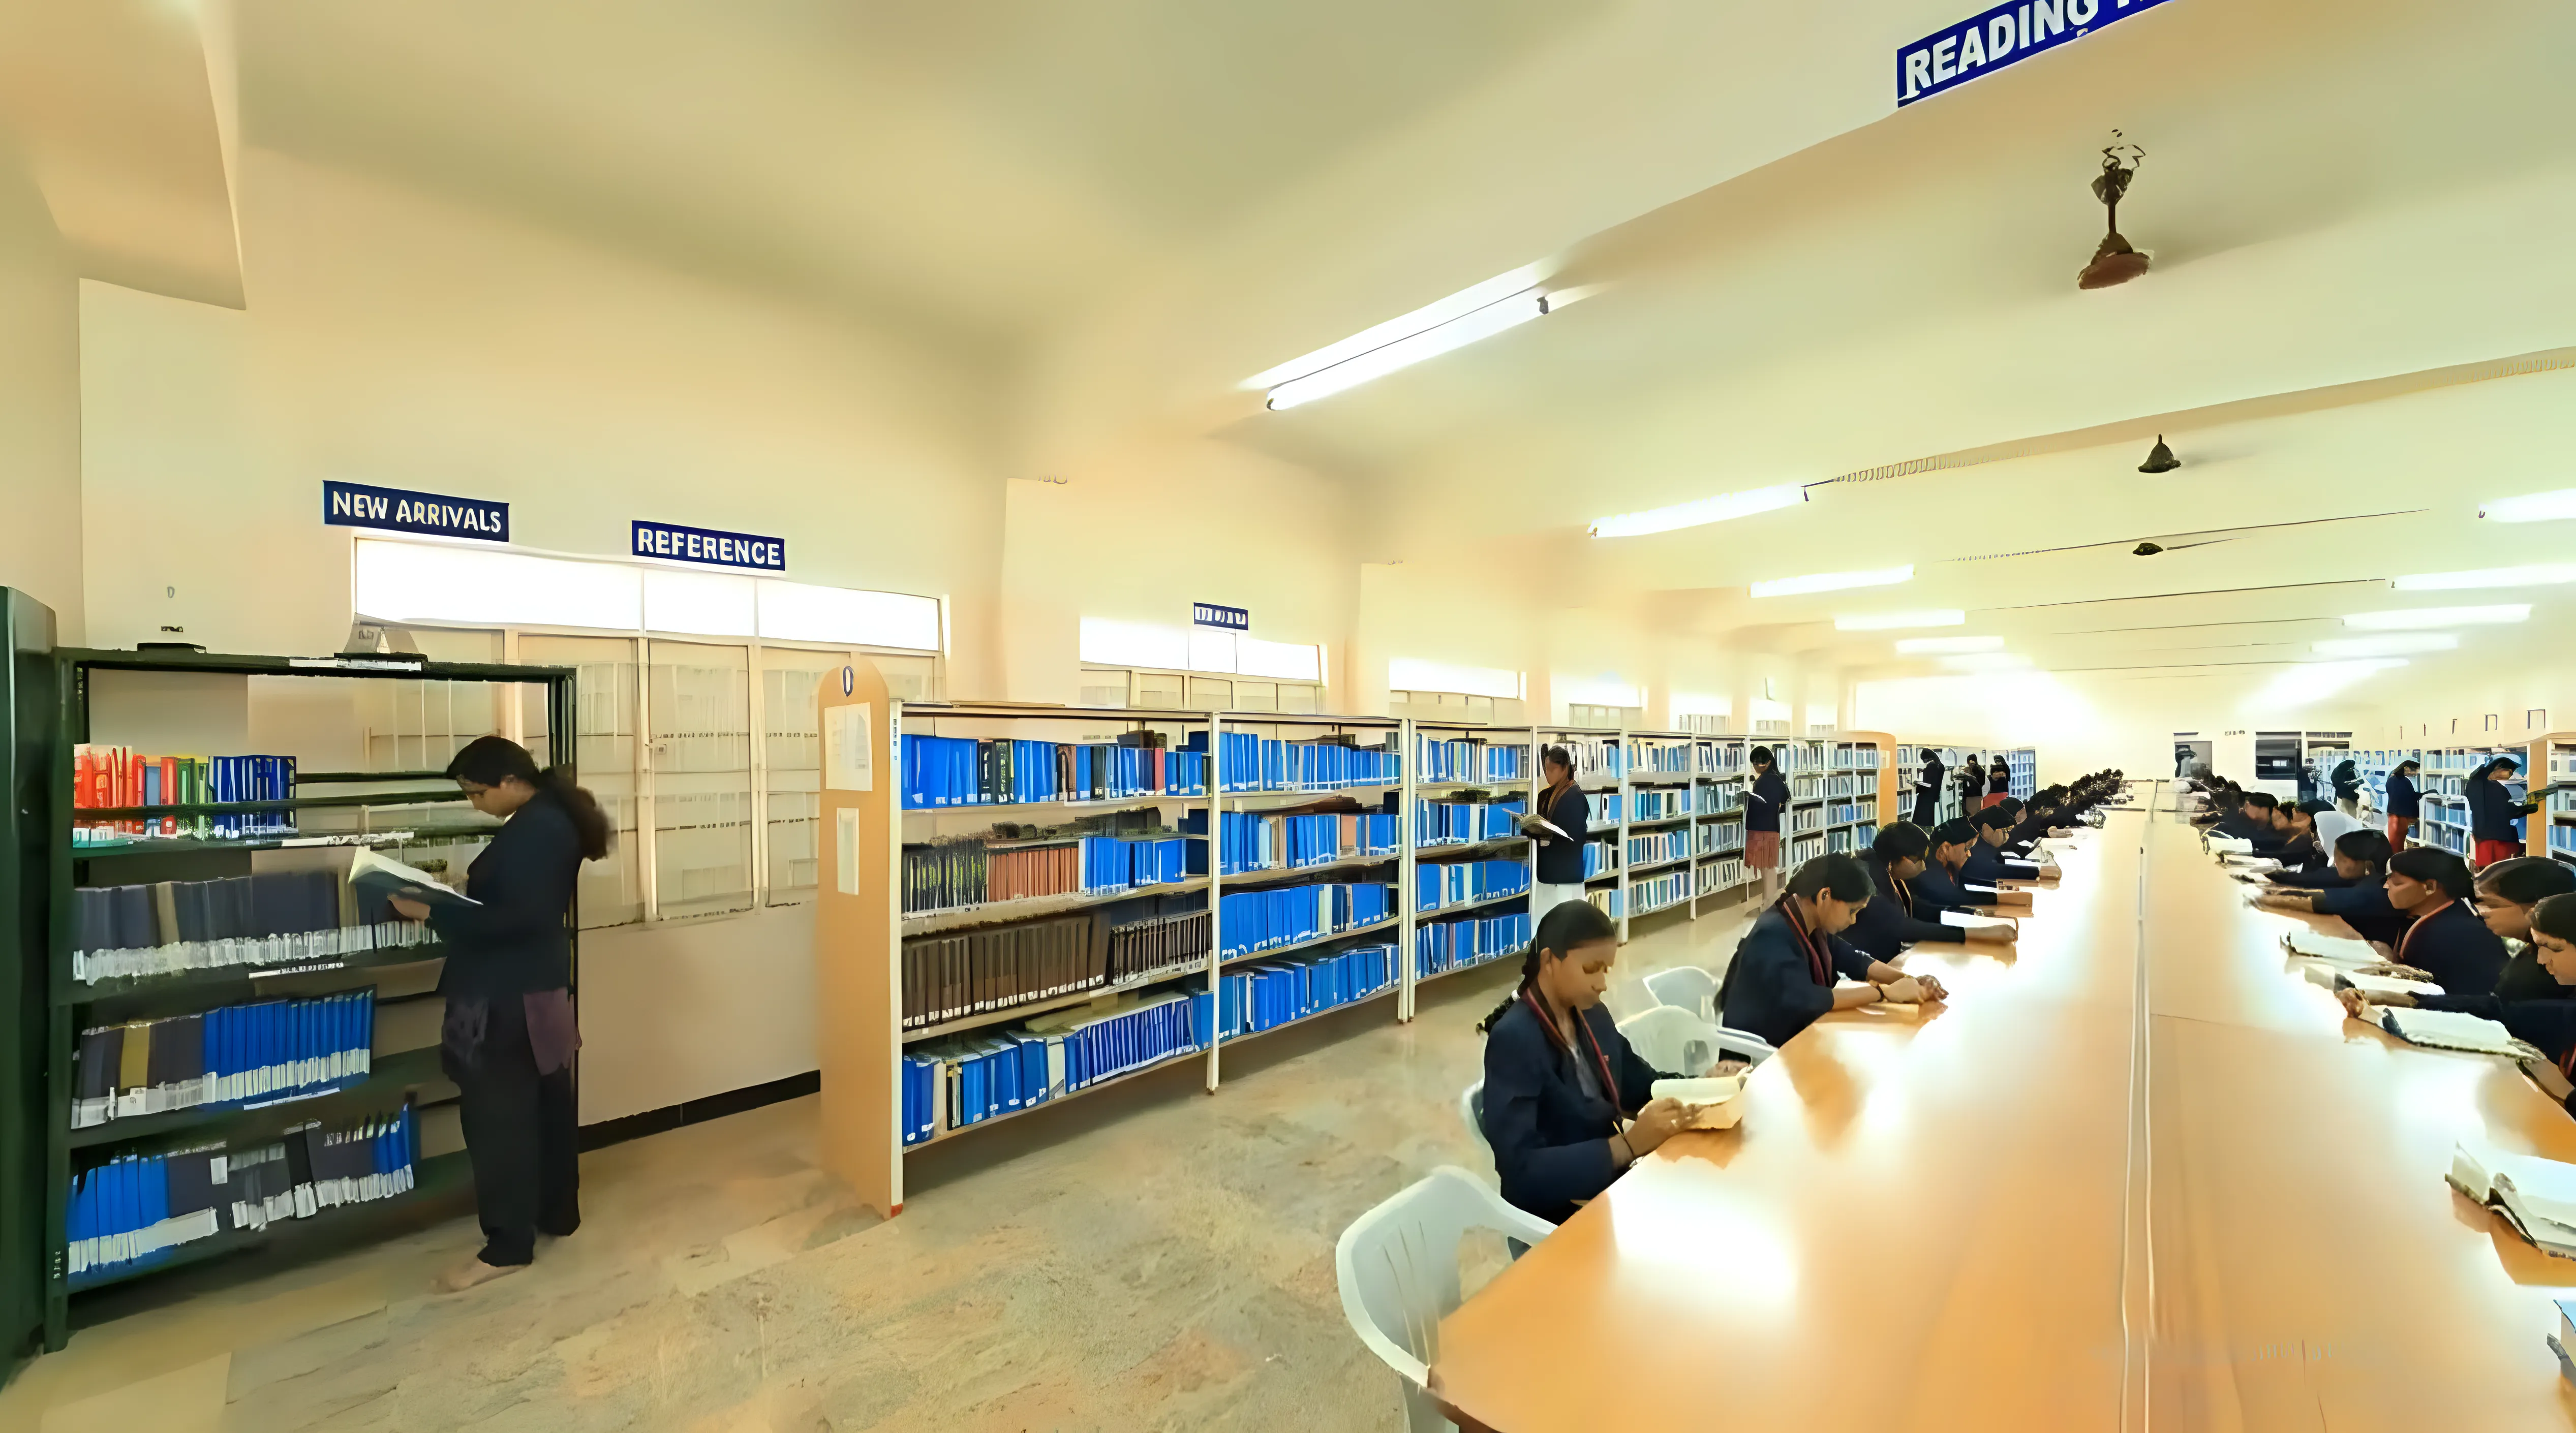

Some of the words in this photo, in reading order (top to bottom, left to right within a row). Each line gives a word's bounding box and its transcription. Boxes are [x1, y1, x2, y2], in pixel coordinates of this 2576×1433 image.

[333, 490, 388, 519] NEW
[395, 499, 501, 533] ARRIVALS
[638, 528, 781, 566] REFERENCE
